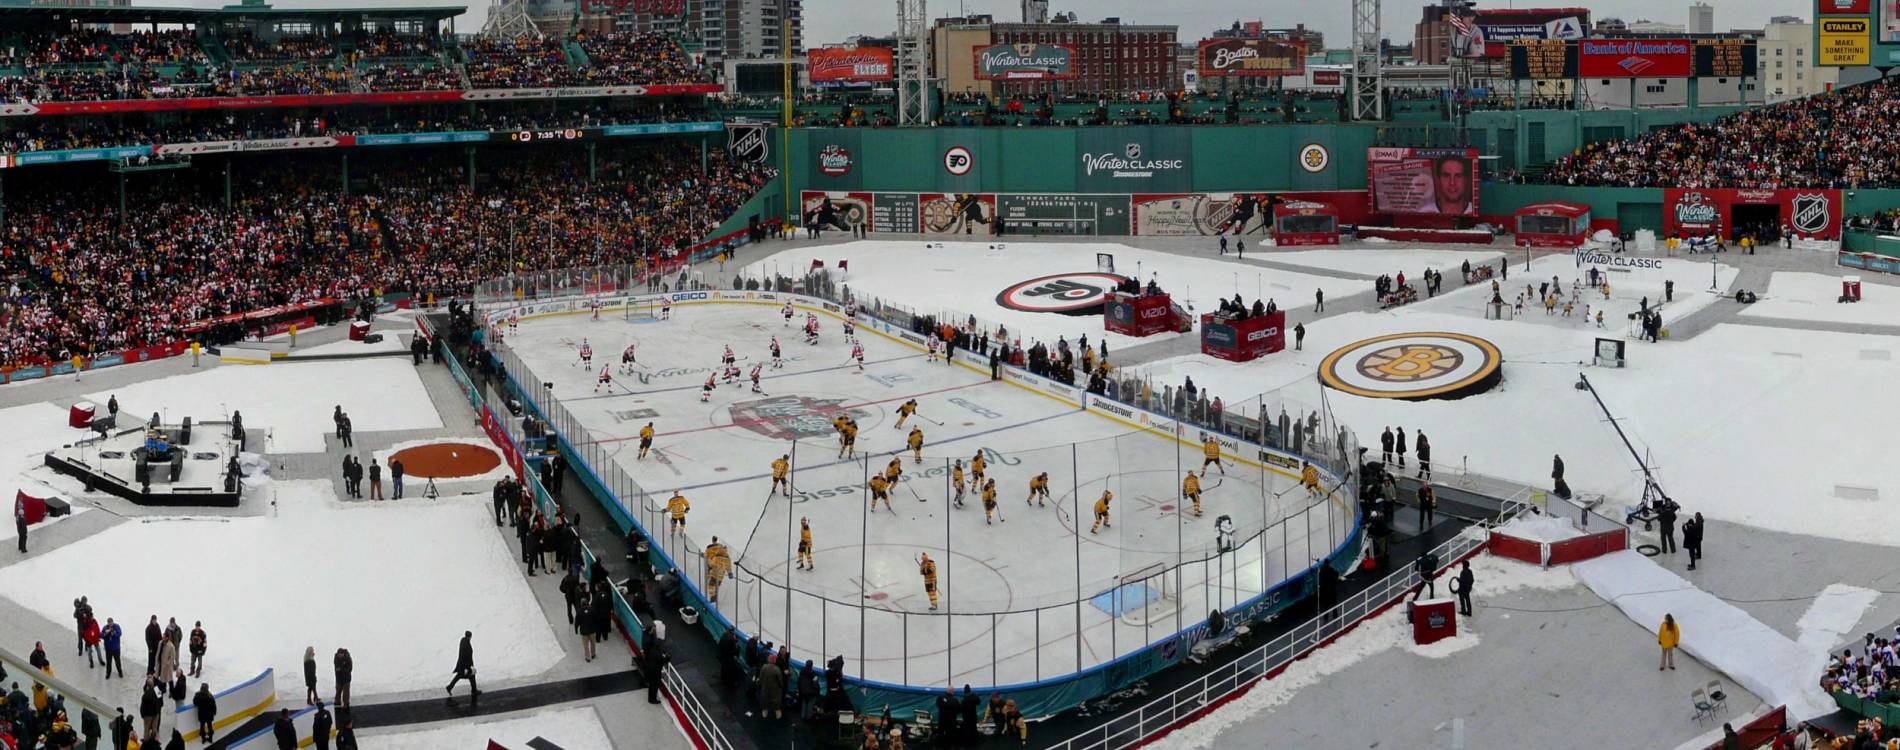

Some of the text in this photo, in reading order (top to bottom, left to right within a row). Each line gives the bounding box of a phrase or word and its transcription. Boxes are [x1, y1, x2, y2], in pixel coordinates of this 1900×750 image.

[1497, 26, 1516, 34] happens
[1826, 23, 1863, 31] STANLEY
[1584, 42, 1687, 55] Bank of America
[854, 63, 888, 75] FLYERS
[982, 52, 1065, 72] Winter CLASSIC
[1243, 57, 1291, 69] BRUINS
[736, 133, 760, 156] NHL
[1083, 153, 1182, 176] Winter CLASSIC
[1212, 206, 1231, 225] NHL
[1676, 203, 1715, 222] Winter
[1800, 205, 1822, 225] NHL
[1572, 246, 1662, 269] Winter CLASSIC
[672, 292, 707, 302] GEICO
[1140, 308, 1167, 319] VIZIO
[1247, 326, 1278, 342] GEICO
[1092, 398, 1133, 419] BRIDGESTONE
[1232, 591, 1281, 626] CLASSIC
